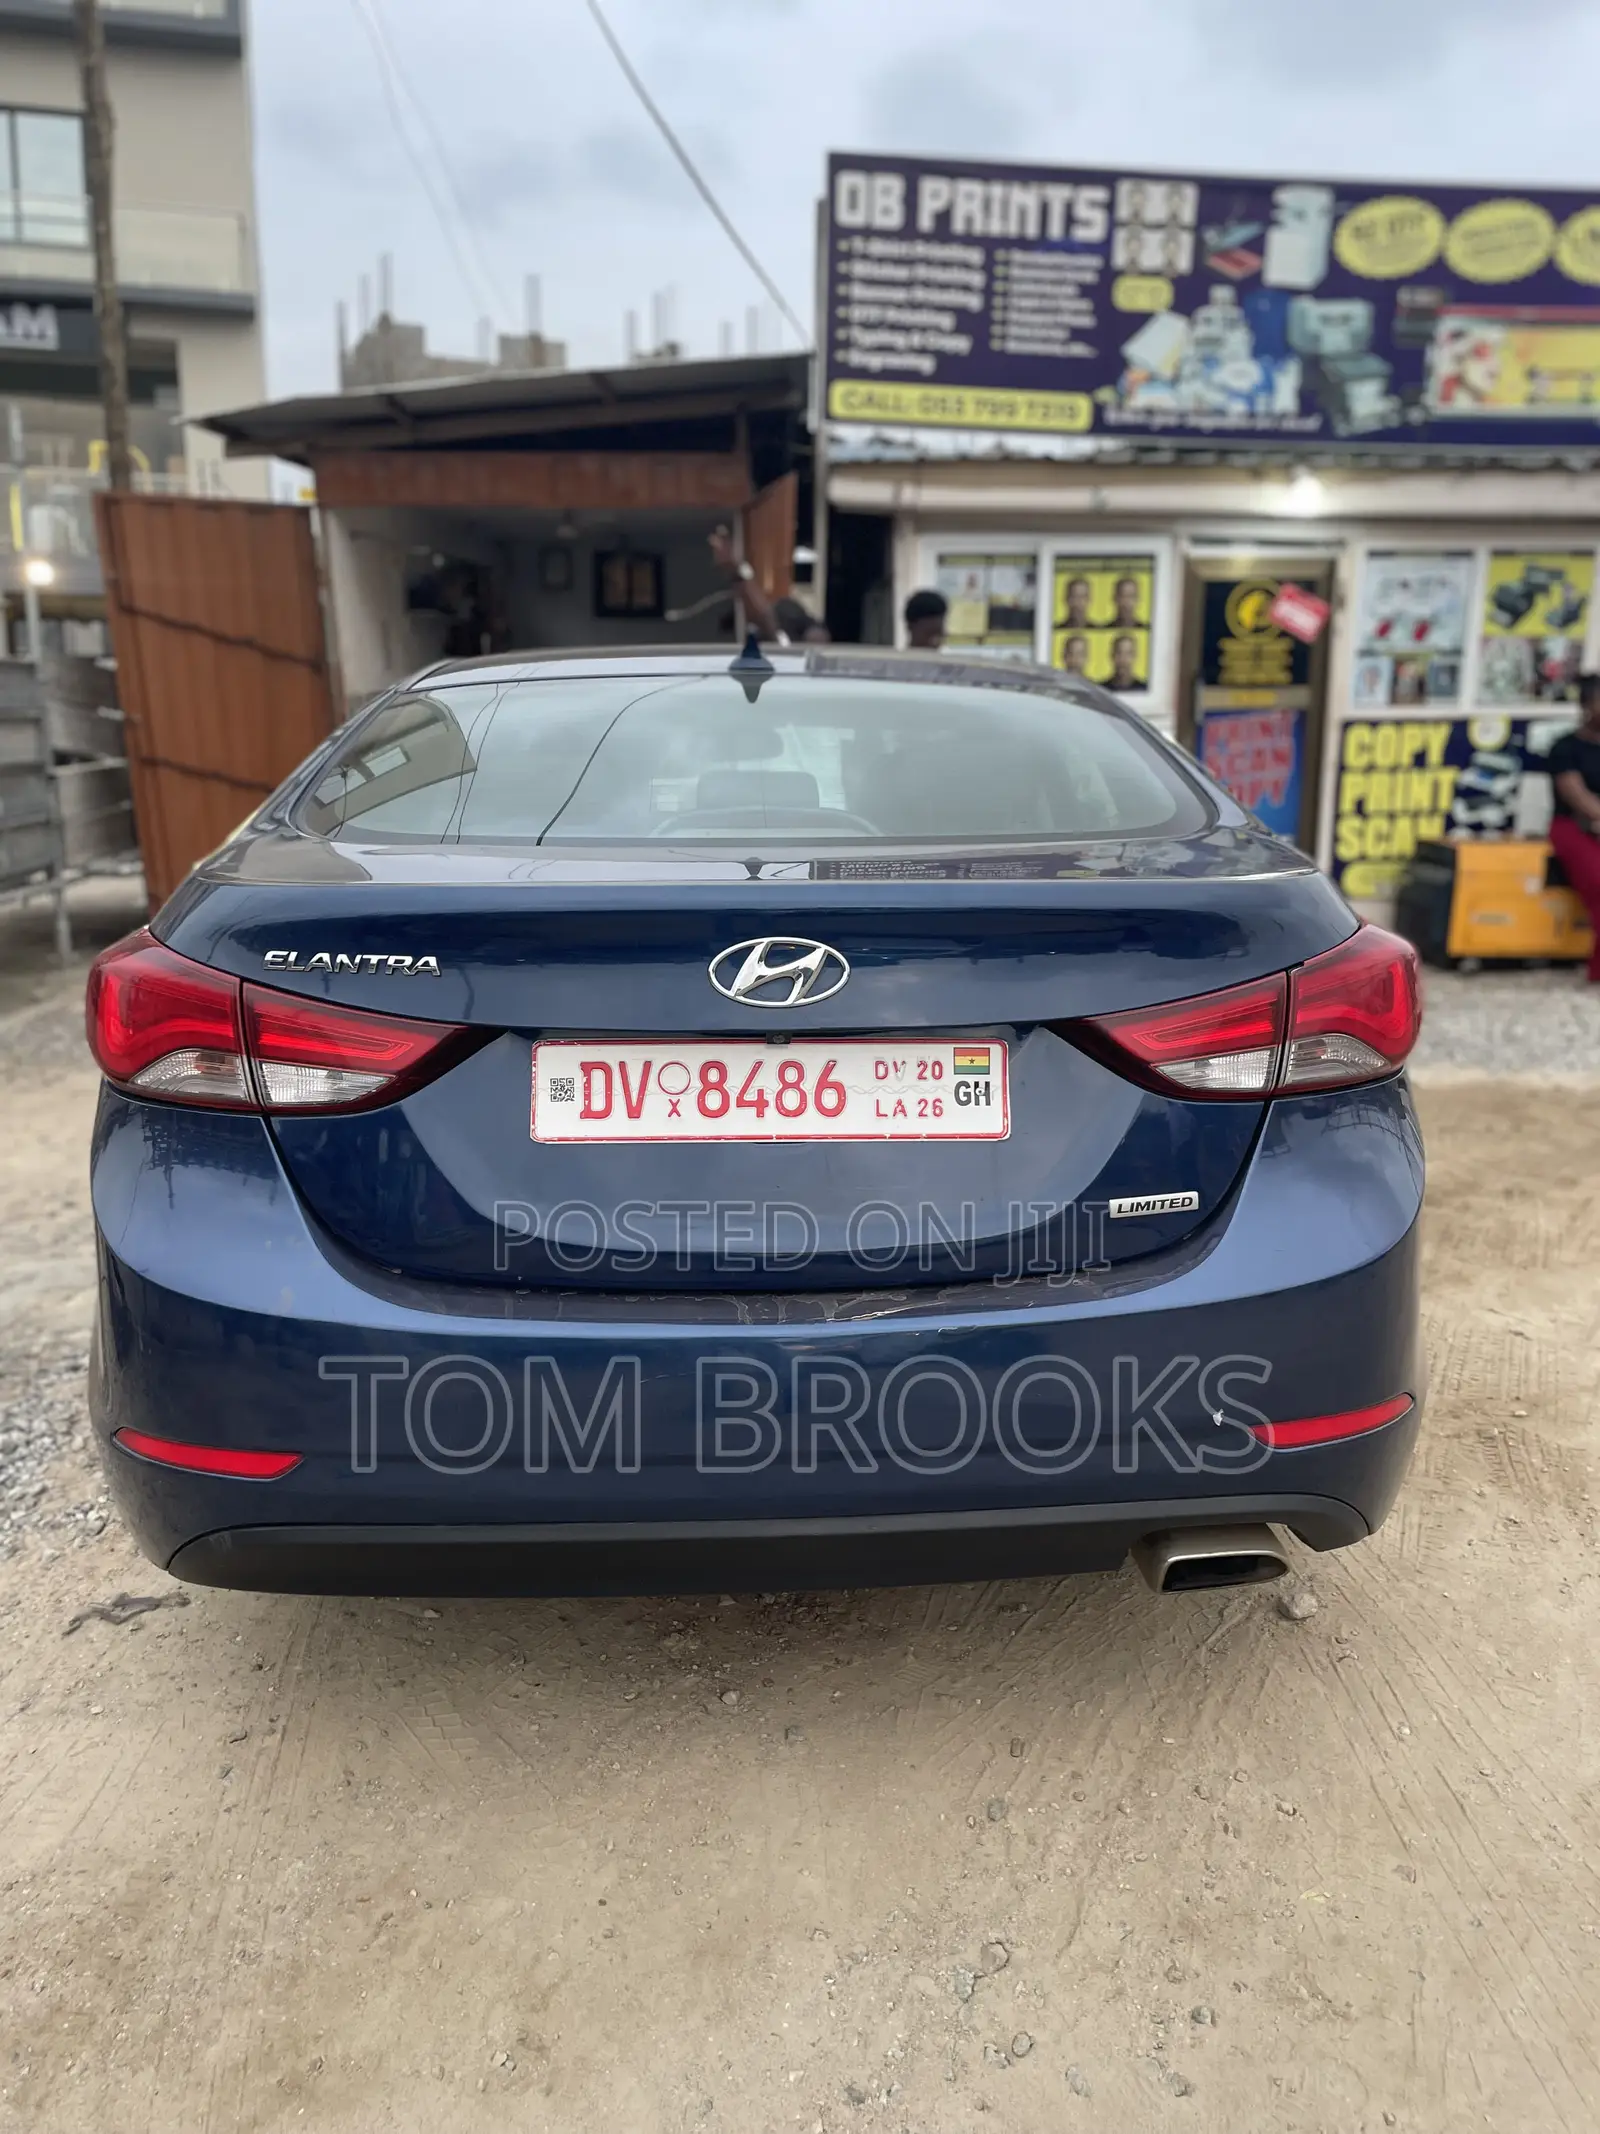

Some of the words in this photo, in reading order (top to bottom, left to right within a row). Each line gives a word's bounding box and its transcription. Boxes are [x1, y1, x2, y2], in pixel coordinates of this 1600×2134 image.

[917, 174, 1110, 243] PRINTS
[1344, 722, 1452, 767] COPY
[1341, 766, 1460, 814] PRINT
[263, 950, 441, 977] ELANTRA
[874, 1060, 906, 1081] DV
[916, 1060, 943, 1080] 20
[580, 1060, 652, 1119] DV
[697, 1060, 847, 1118] 8486
[954, 1080, 991, 1107] GH
[875, 1098, 908, 1117] LA
[917, 1098, 944, 1117] 26
[1117, 1197, 1194, 1214] LIMITED
